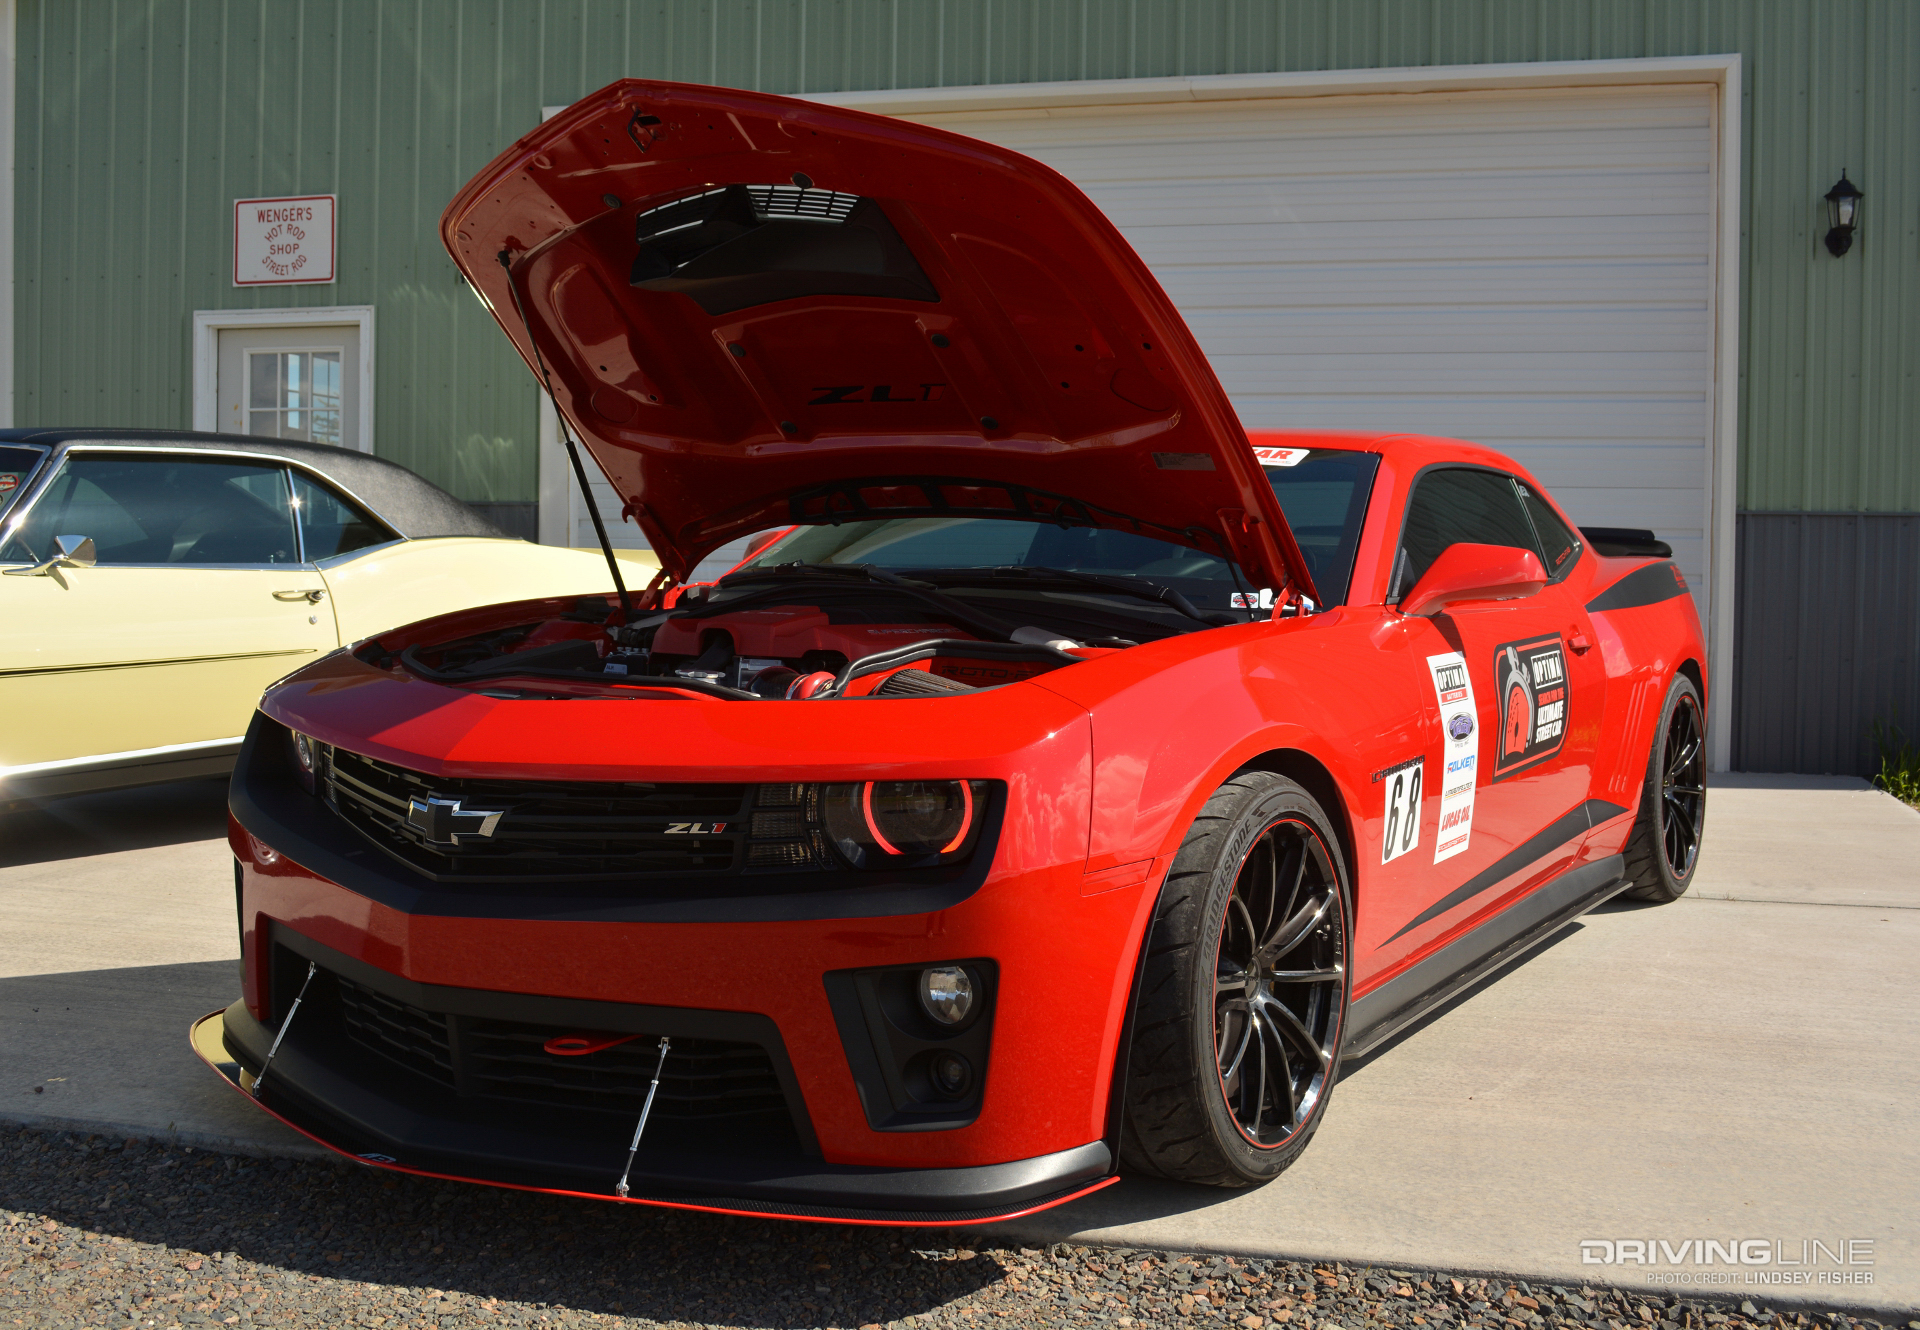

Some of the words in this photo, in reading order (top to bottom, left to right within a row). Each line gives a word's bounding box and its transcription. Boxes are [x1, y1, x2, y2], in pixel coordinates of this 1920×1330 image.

[257, 206, 313, 223] WENGER'S
[264, 224, 283, 243] HOT
[286, 223, 306, 241] ROD
[269, 243, 300, 255] SHOP
[261, 256, 289, 276] STREET
[291, 254, 307, 273] ROD
[1252, 448, 1294, 460] AR
[1436, 667, 1465, 690] OPTIMA
[1533, 655, 1562, 684] OPTIMA
[1537, 700, 1564, 726] ULTIMATE
[1535, 722, 1553, 743] STREET
[1552, 719, 1562, 737] CAR
[1447, 755, 1475, 774] FALKEN
[1384, 767, 1421, 861] 68
[1441, 808, 1462, 832] LUCAS
[1460, 805, 1471, 823] OIL
[663, 822, 728, 834] ZL1
[1204, 818, 1253, 961] BRIDGESTONE
